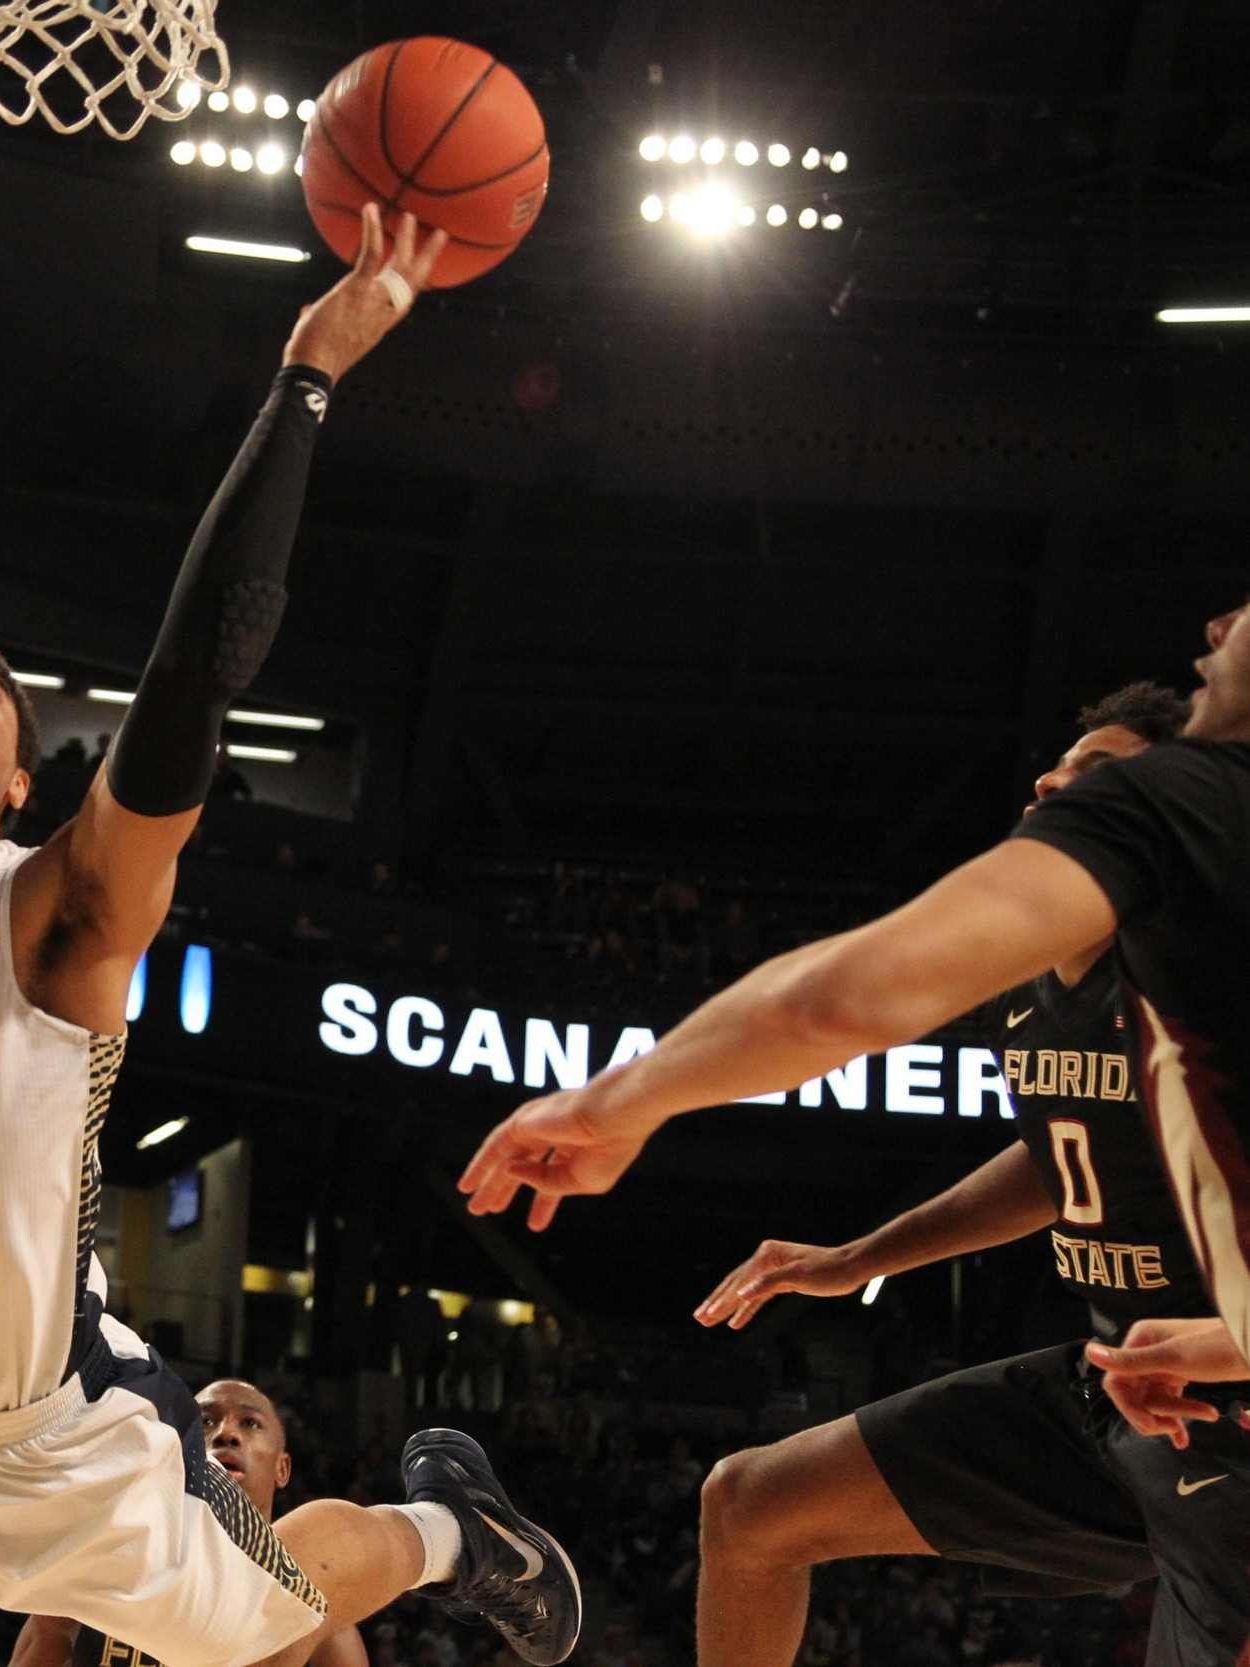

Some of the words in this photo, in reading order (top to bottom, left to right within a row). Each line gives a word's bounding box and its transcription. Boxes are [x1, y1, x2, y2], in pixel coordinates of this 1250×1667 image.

[729, 1044, 1021, 1119] NER
[1004, 1049, 1138, 1102] FLORID
[1047, 1118, 1103, 1228] 0
[1051, 1229, 1171, 1290] STATE
